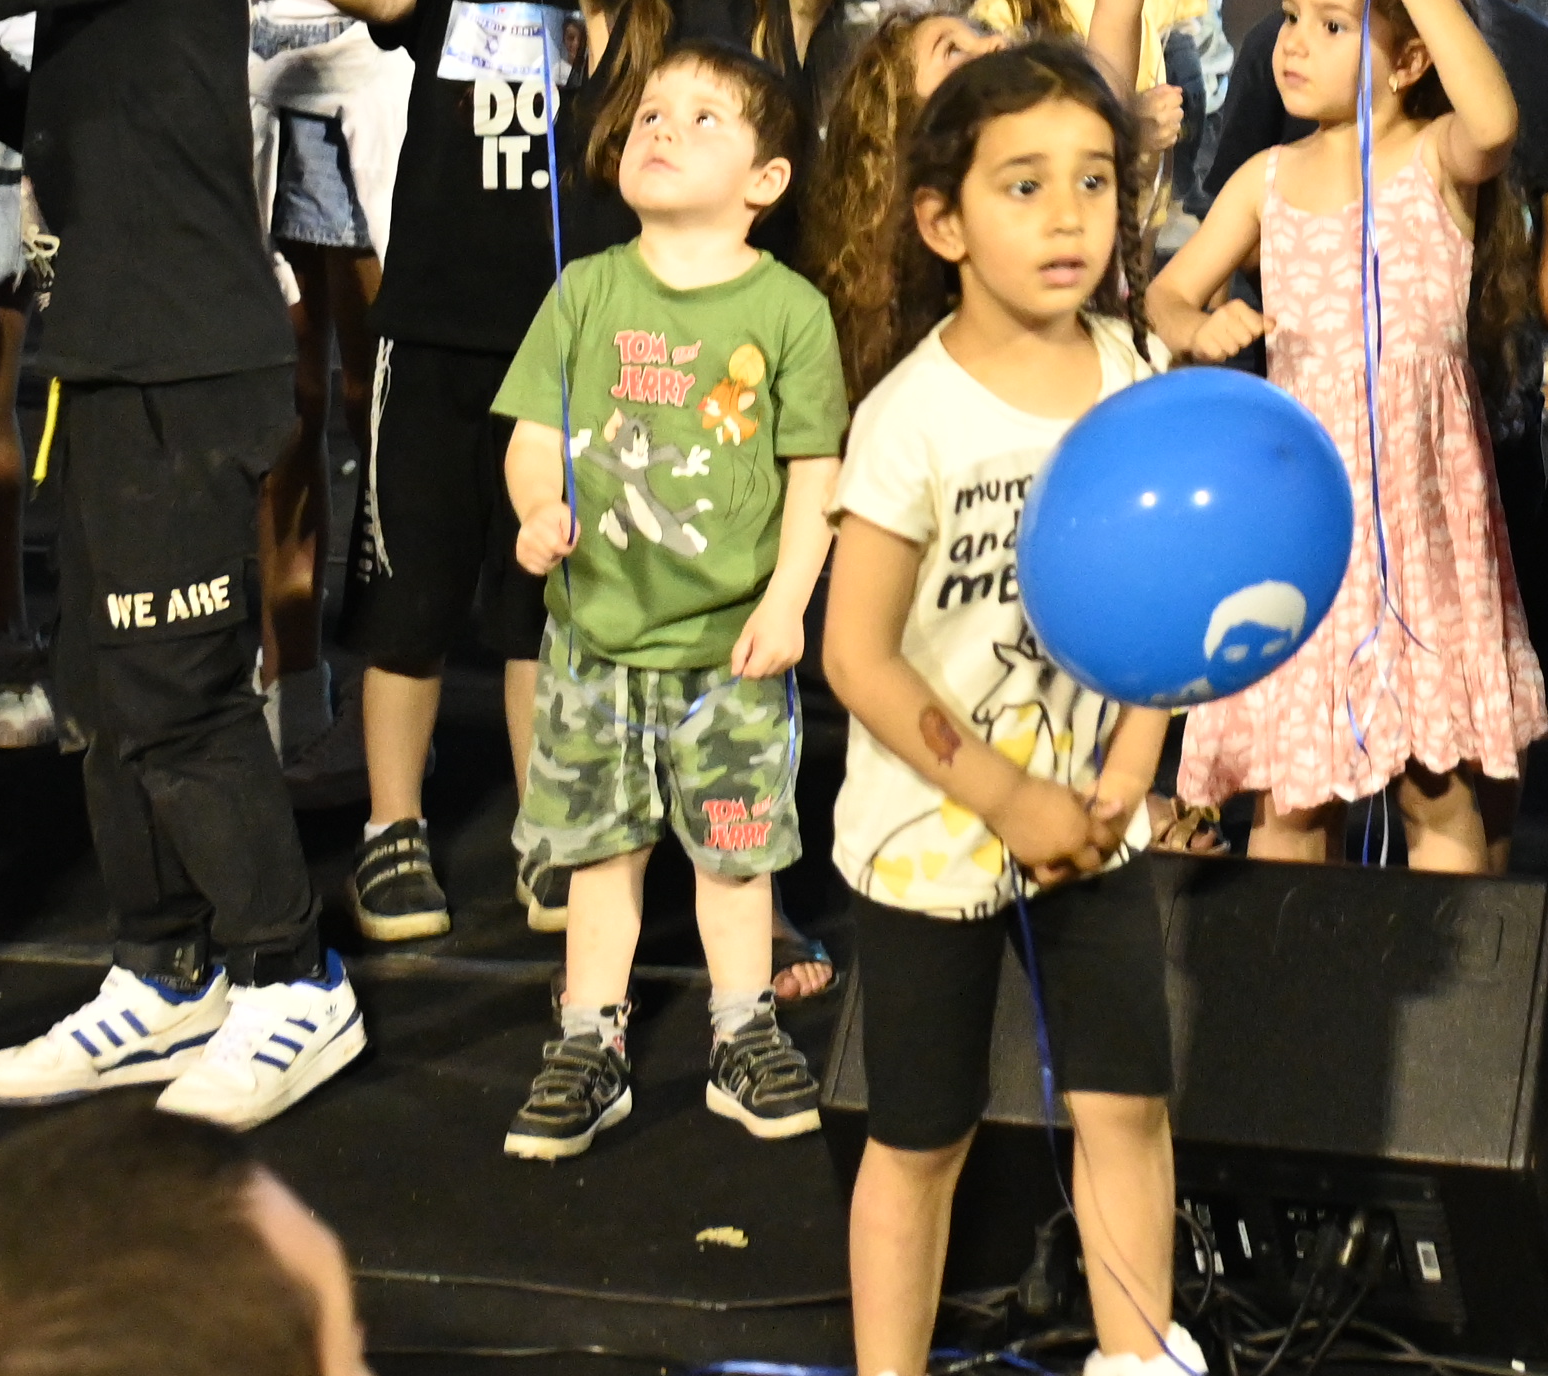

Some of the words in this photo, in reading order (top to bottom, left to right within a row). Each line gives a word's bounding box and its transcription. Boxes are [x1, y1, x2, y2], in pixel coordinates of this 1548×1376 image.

[473, 77, 560, 136] DO
[482, 135, 550, 190] IT.
[614, 330, 667, 364] TOM
[611, 365, 695, 407] JERRY
[107, 592, 157, 629] WE
[167, 574, 230, 624] ARE
[702, 797, 748, 823] TOM
